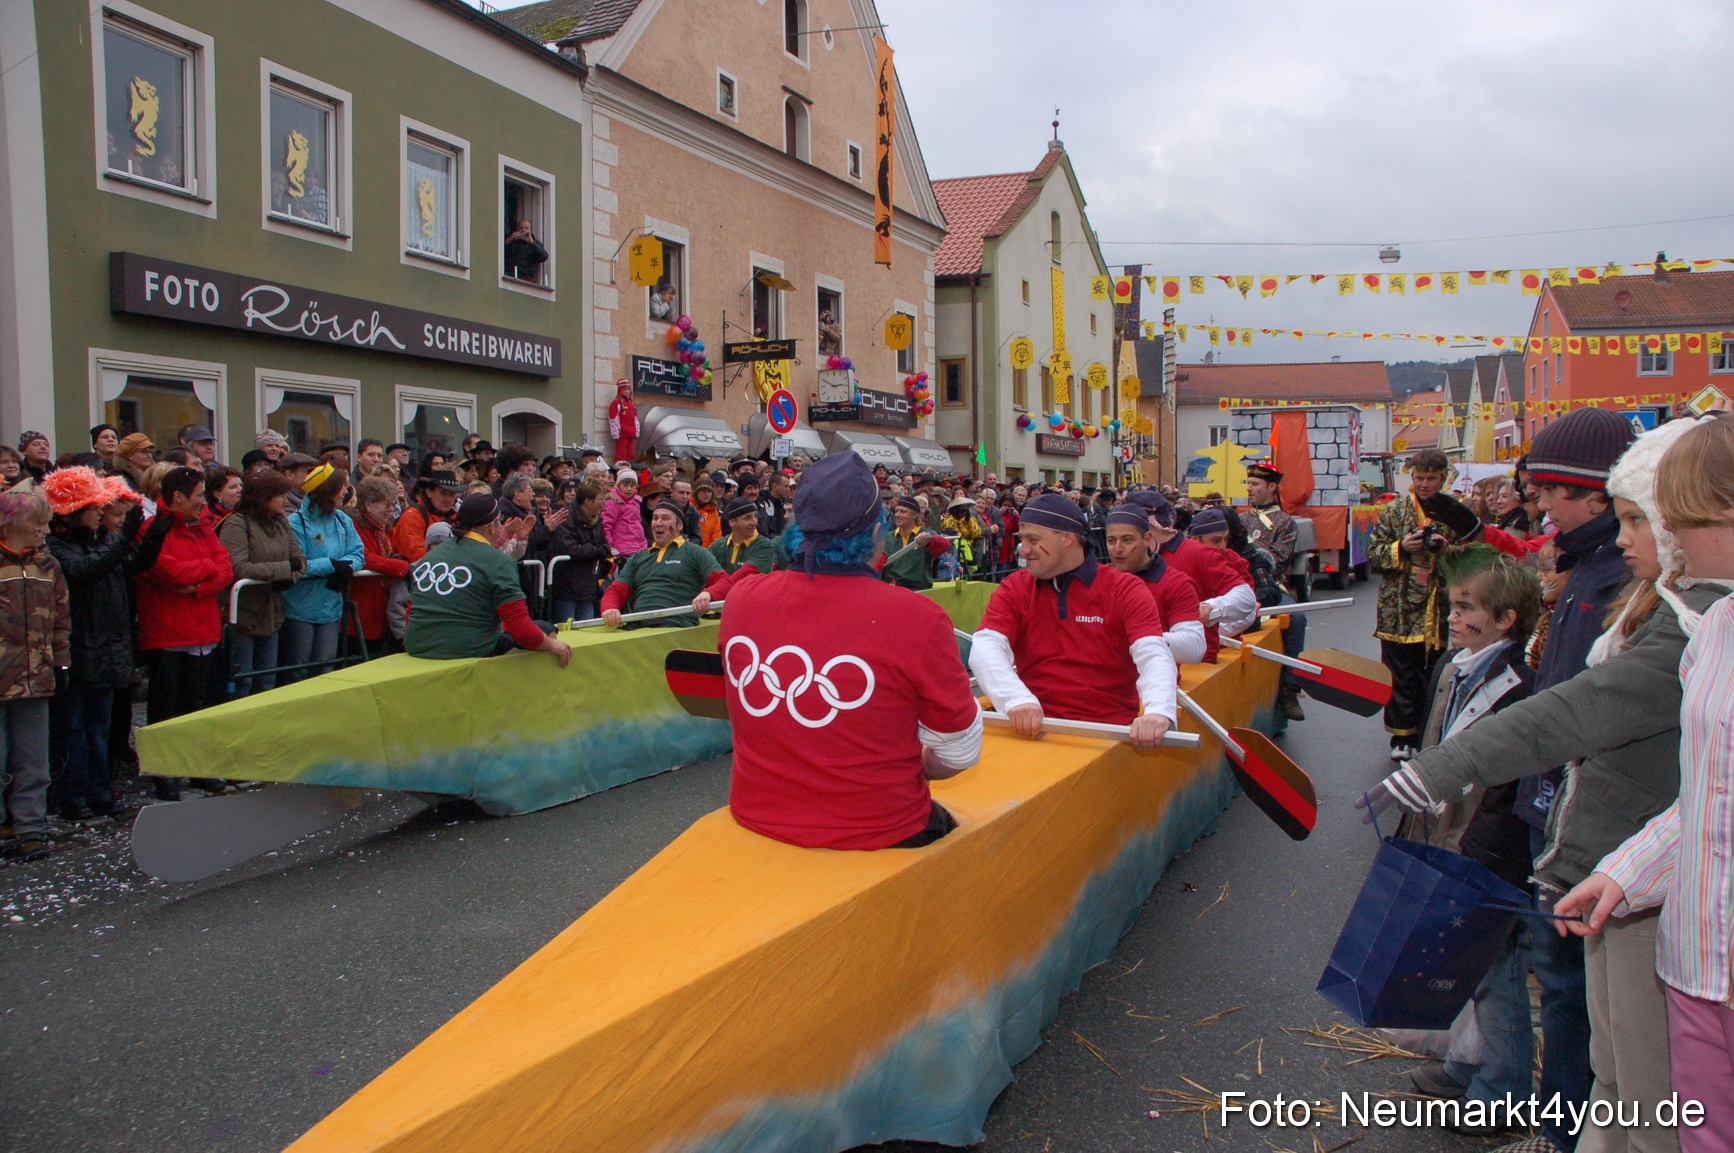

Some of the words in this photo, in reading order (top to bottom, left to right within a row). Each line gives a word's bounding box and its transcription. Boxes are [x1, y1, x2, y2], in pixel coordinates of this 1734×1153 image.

[145, 270, 219, 312] FOTO
[241, 284, 406, 350] Rösch
[424, 323, 553, 368] SCHREIBWAREN
[732, 343, 789, 355] RÖHLICH
[686, 431, 738, 444] RÖHLICH
